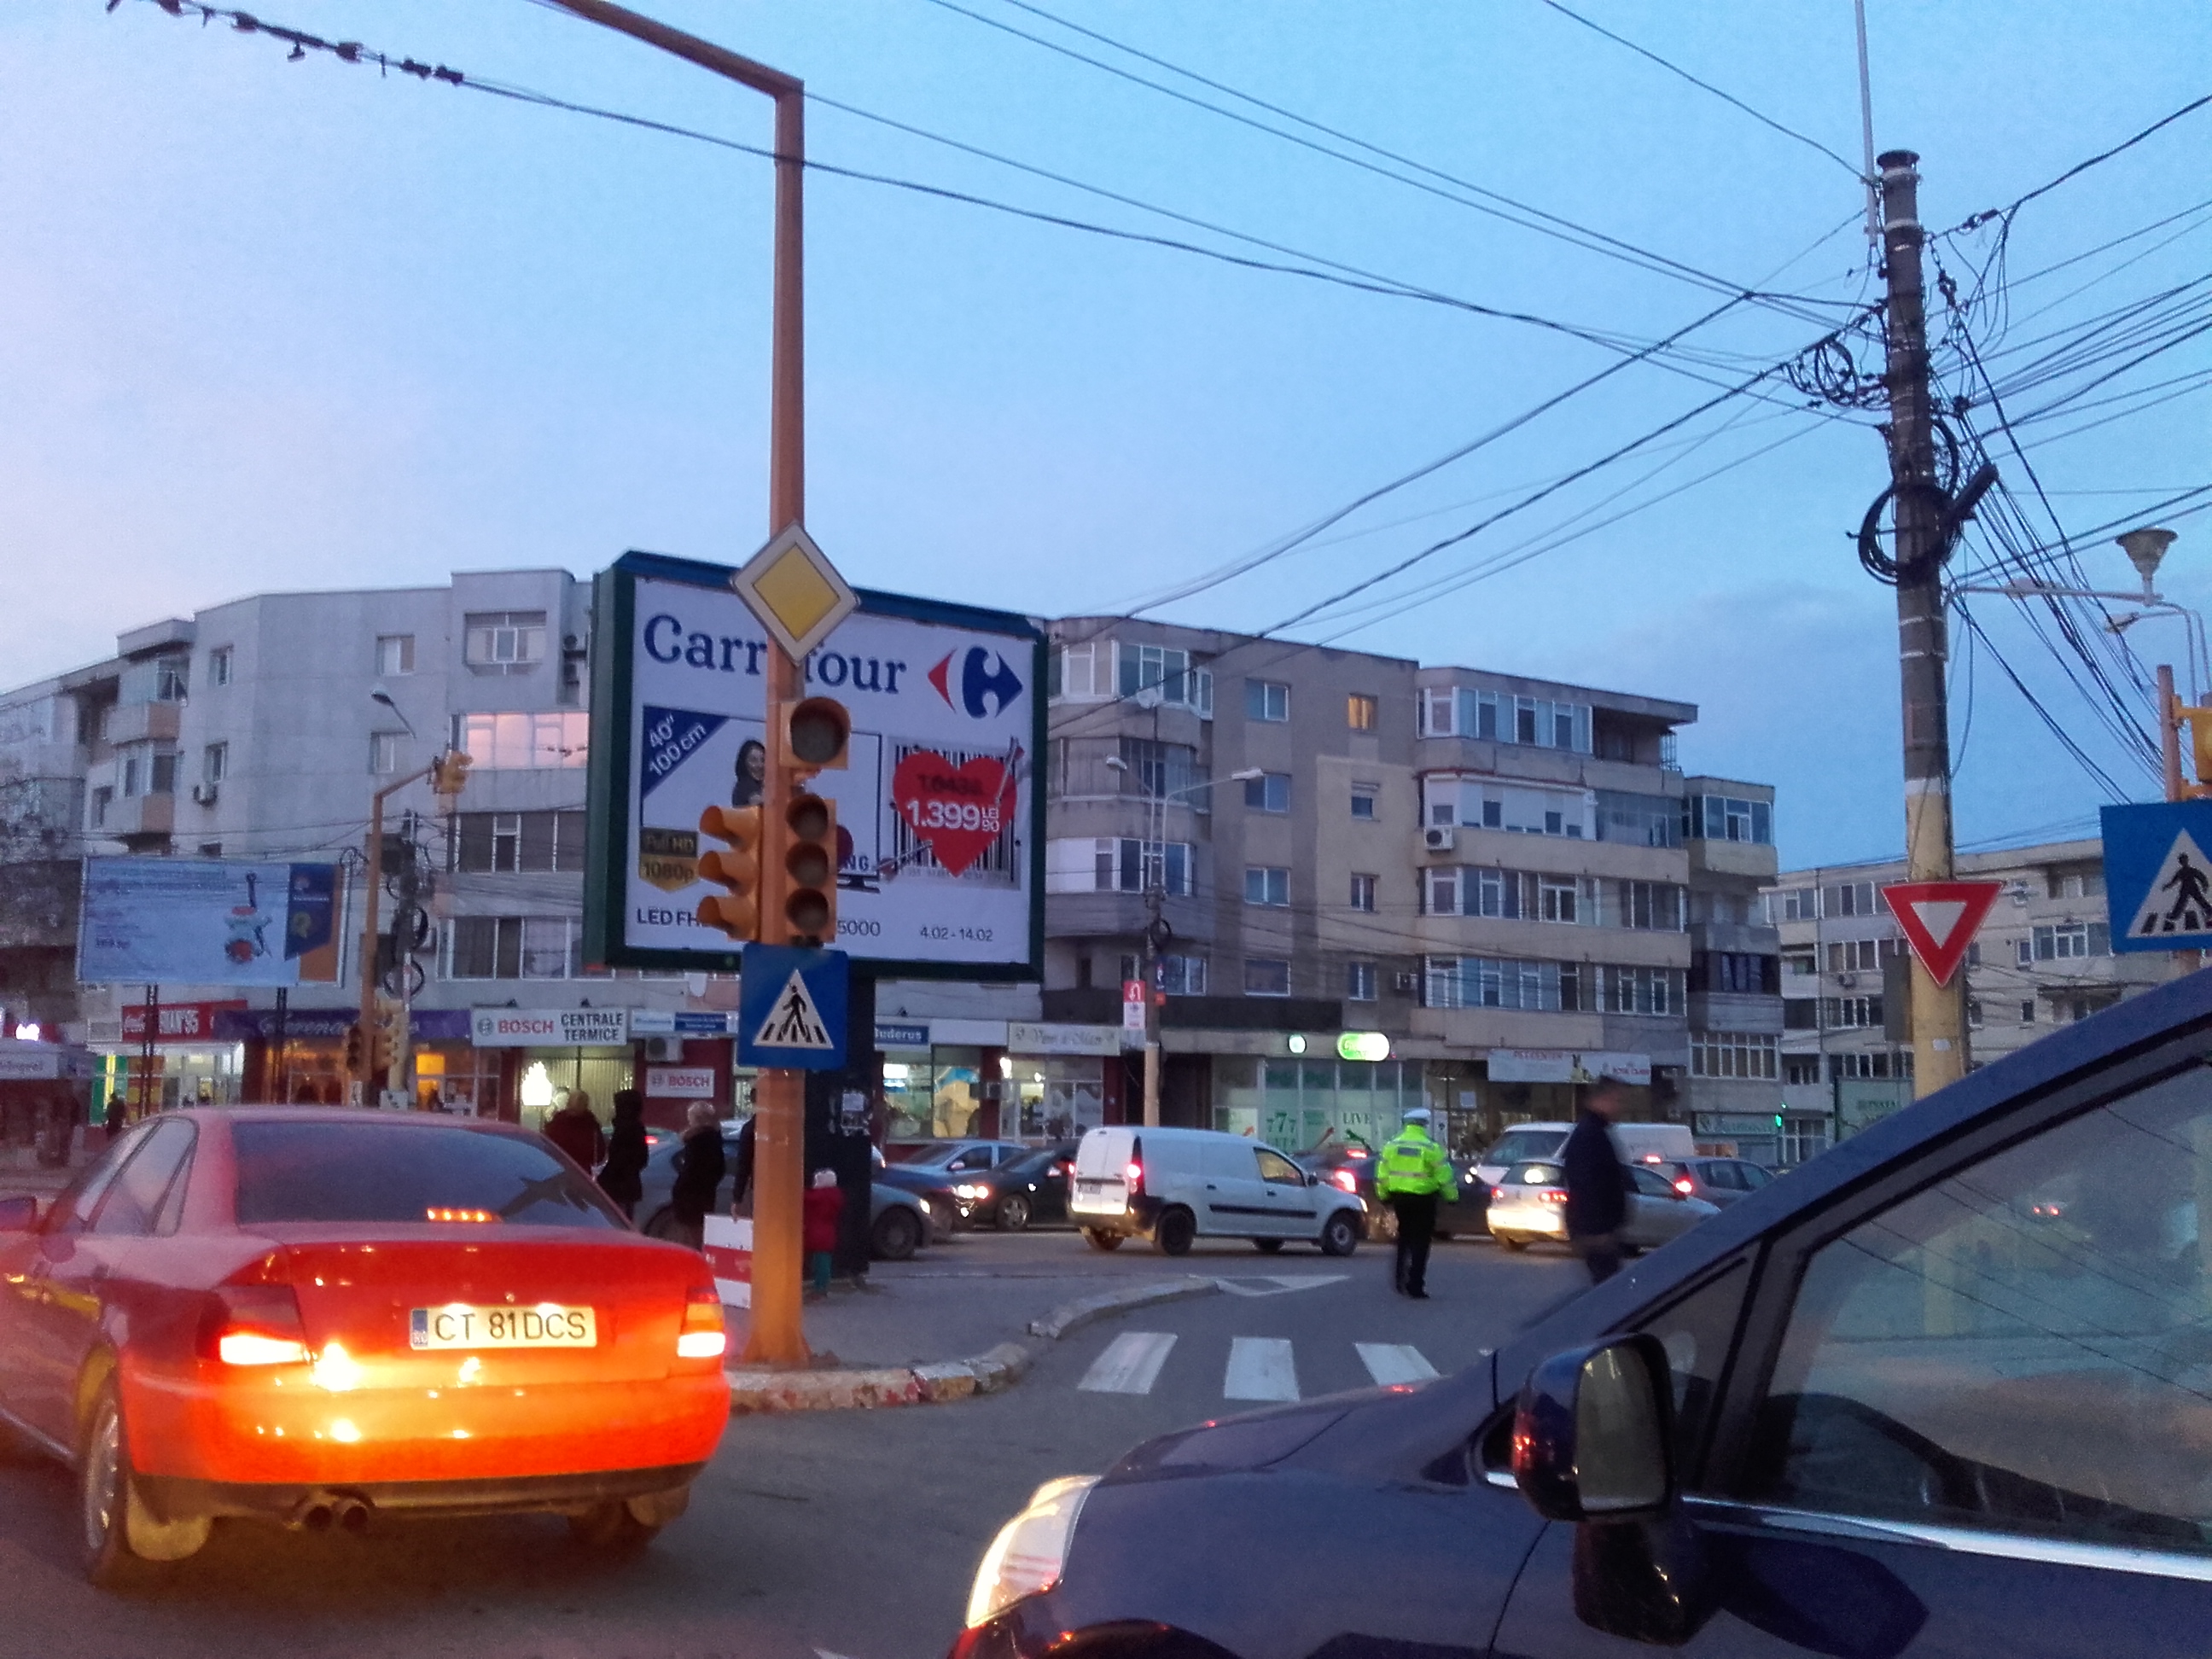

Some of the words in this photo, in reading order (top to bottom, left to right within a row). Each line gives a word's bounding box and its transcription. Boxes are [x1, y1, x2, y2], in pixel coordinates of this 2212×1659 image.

[643, 614, 906, 694] Carrfour
[649, 744, 681, 776] 100
[681, 723, 707, 749] cm
[907, 800, 981, 830] 1.399
[981, 819, 1000, 832] 90
[643, 861, 695, 882] 1080p
[637, 908, 672, 926] LED
[920, 927, 949, 940] 4.02
[959, 928, 993, 941] 14.02
[498, 1019, 555, 1033] BOSCH
[561, 1013, 623, 1025] CENTRALE
[565, 1028, 618, 1041] TERMICE
[668, 1076, 709, 1087] BOSCH
[435, 1313, 475, 1341] CT
